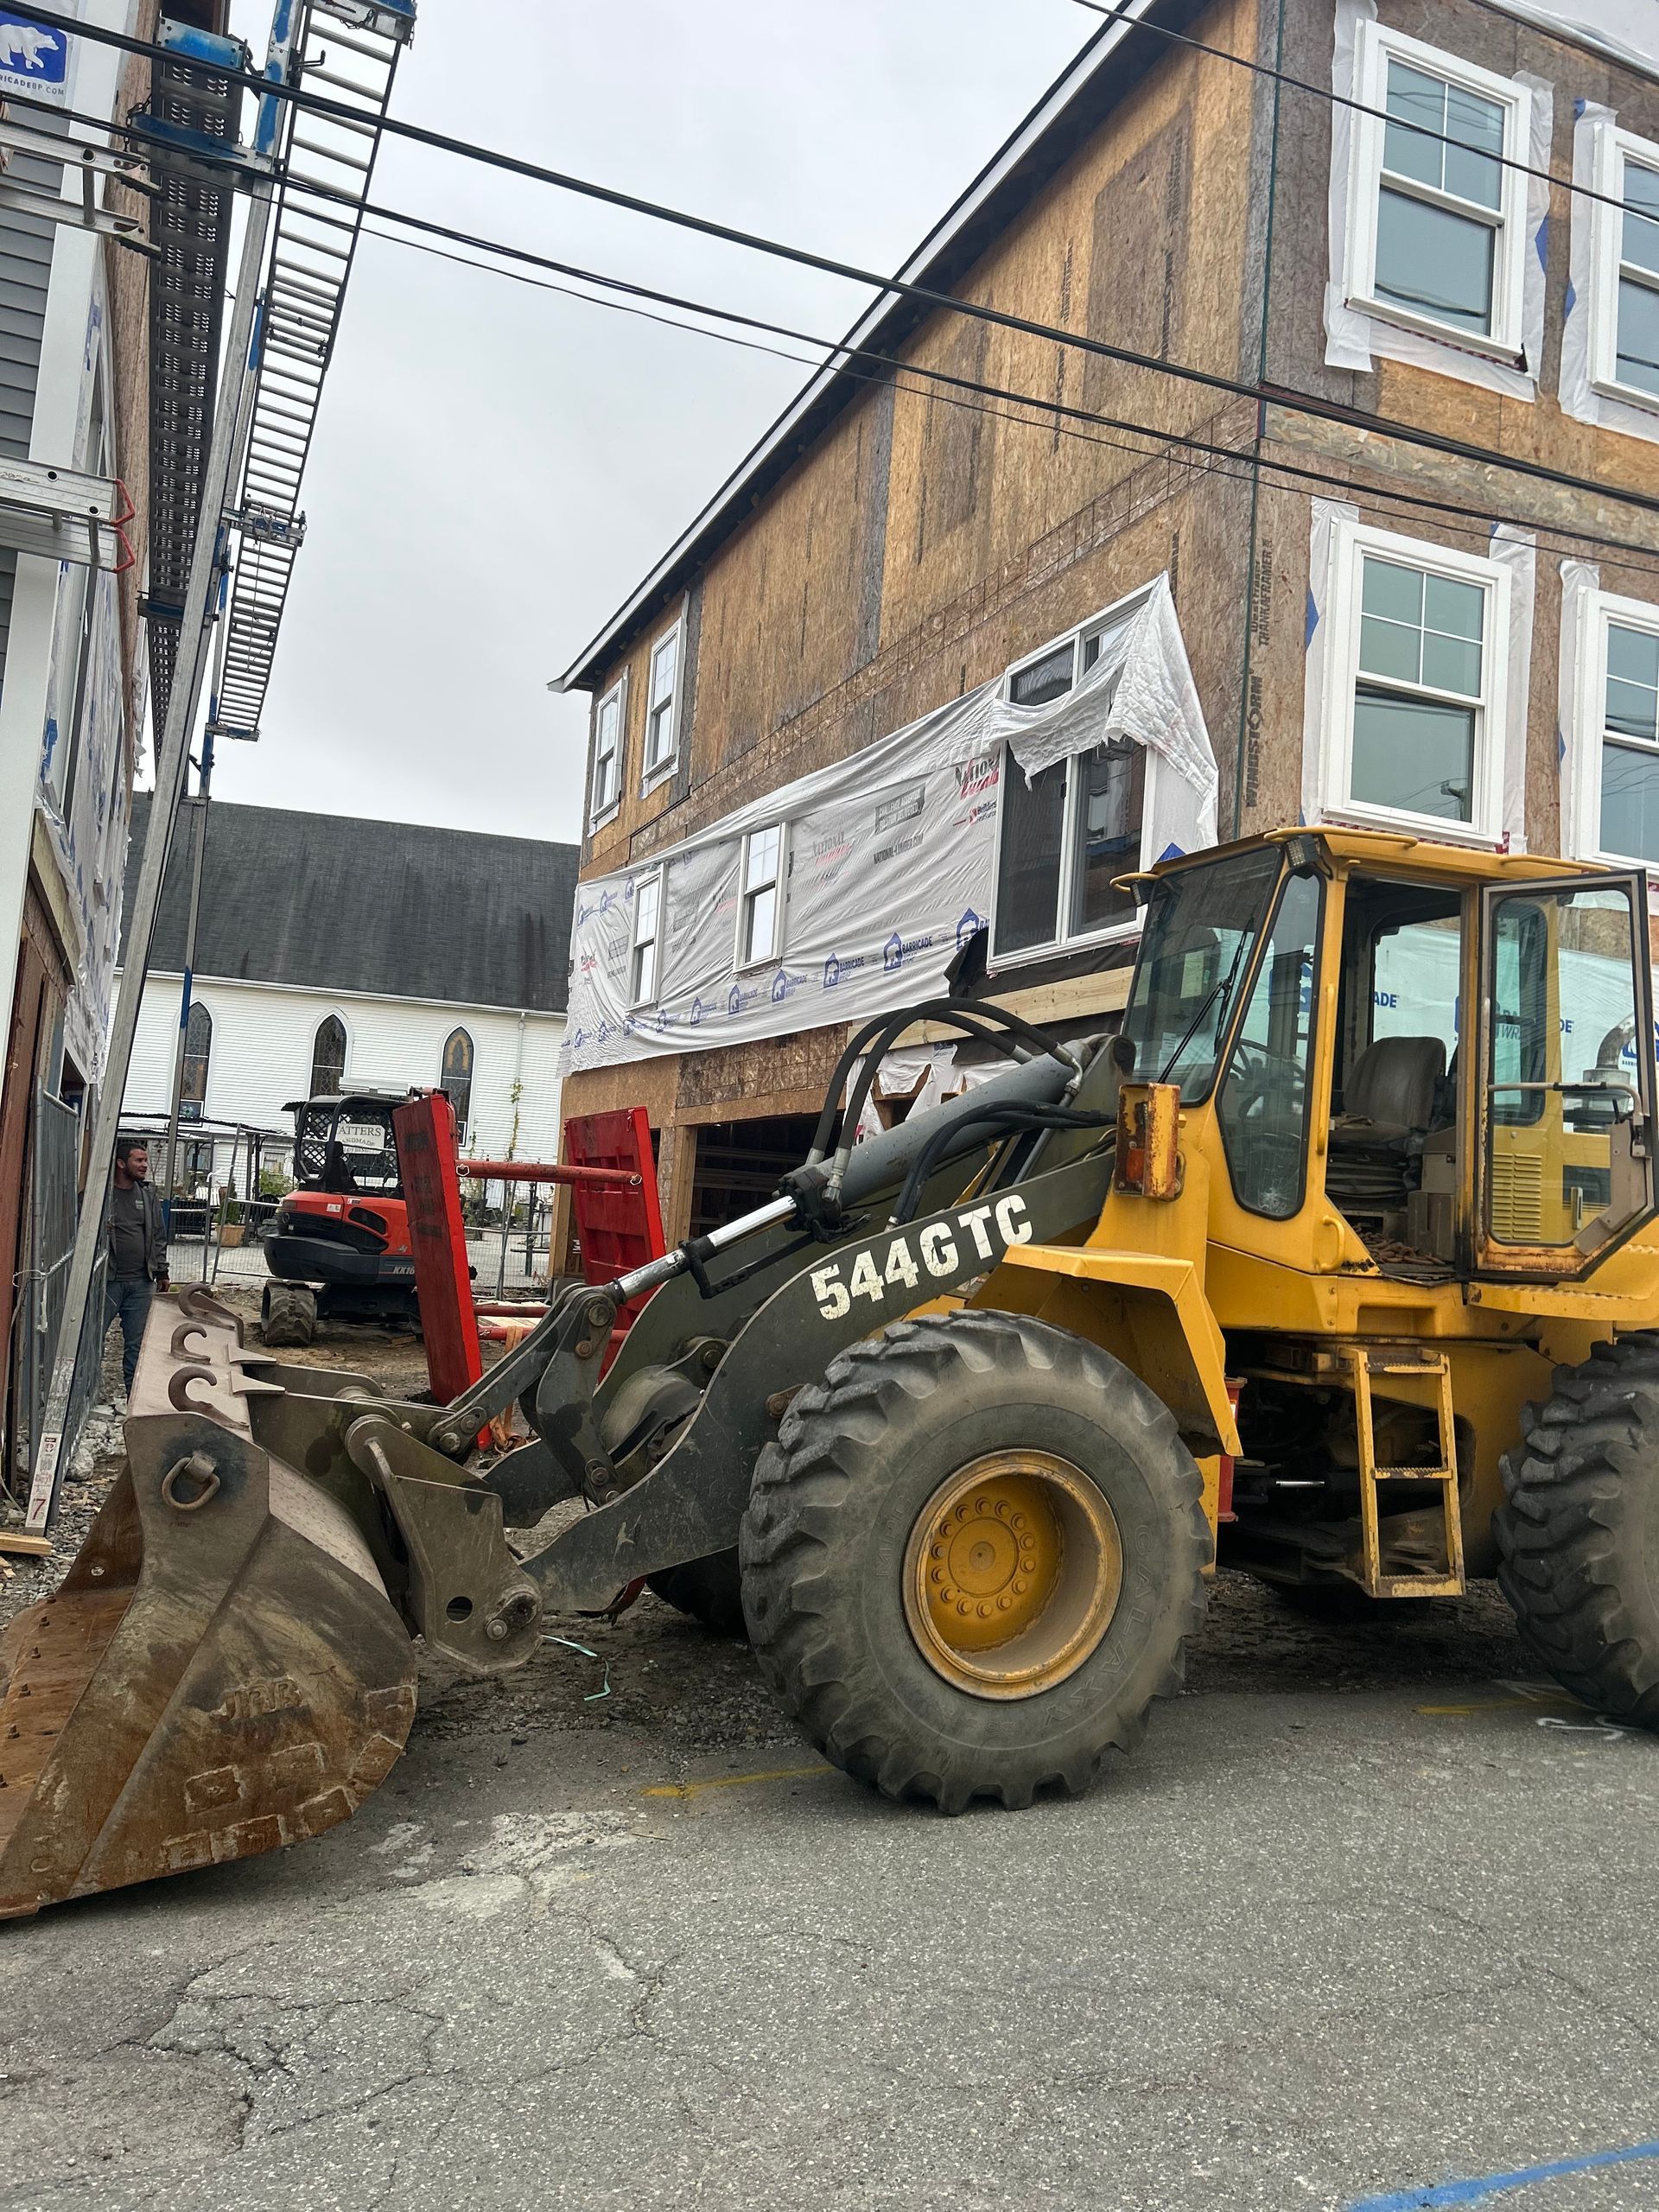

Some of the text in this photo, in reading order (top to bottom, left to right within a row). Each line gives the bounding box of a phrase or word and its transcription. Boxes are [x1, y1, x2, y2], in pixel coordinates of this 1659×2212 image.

[1246, 676, 1265, 808] WINDSTORM
[902, 936, 933, 954] BARRICADE
[338, 1125, 381, 1137] ATTERS
[810, 1194, 1033, 1320] 544GTC
[209, 1676, 303, 1721] JRB
